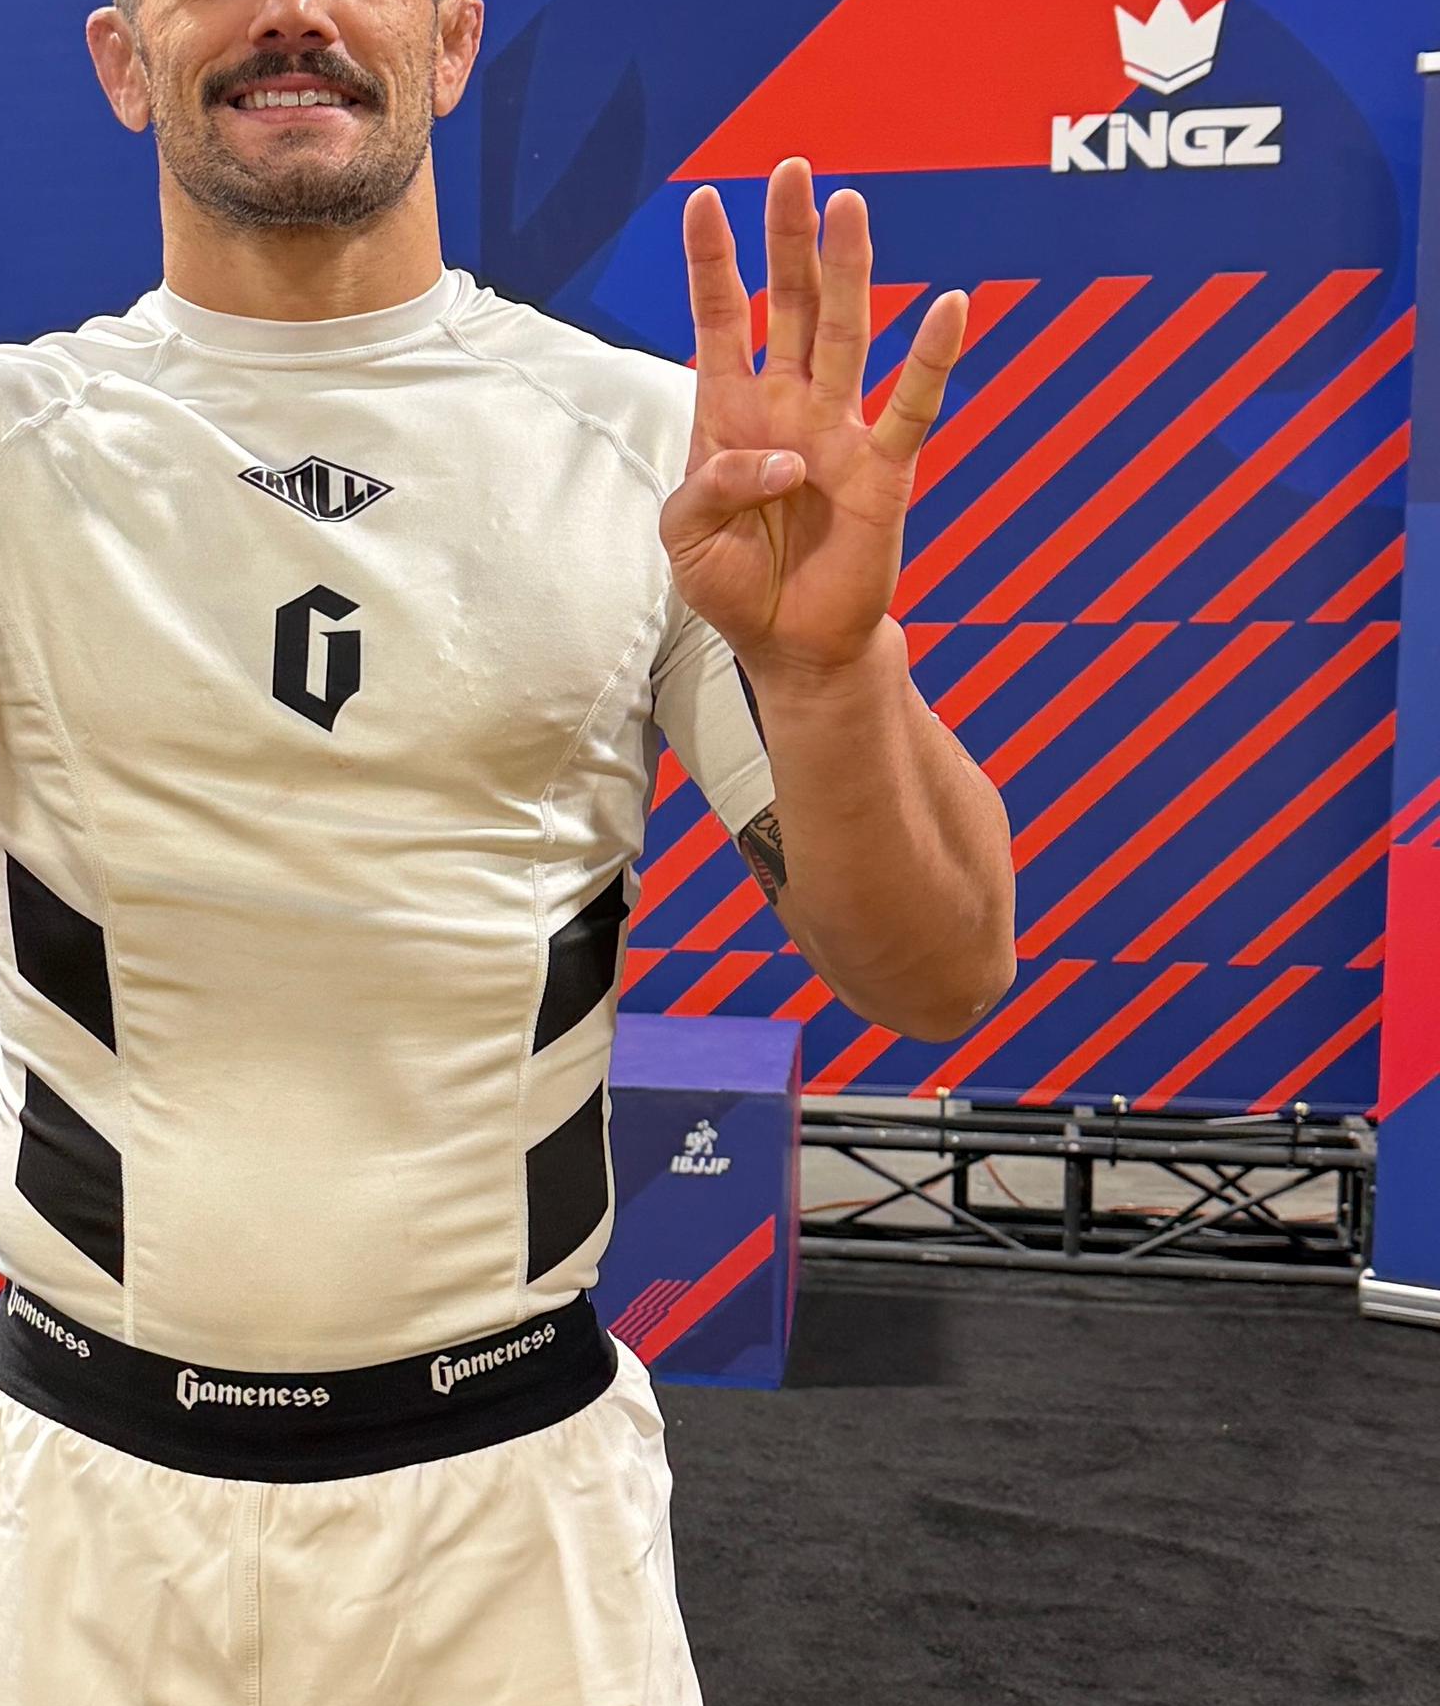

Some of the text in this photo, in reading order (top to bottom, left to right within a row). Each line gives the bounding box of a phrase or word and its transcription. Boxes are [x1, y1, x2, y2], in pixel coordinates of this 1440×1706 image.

[272, 584, 361, 733] G
[670, 1155, 731, 1175] IBJJF
[431, 1322, 556, 1395] Gameness
[176, 1367, 331, 1410] Gameness
